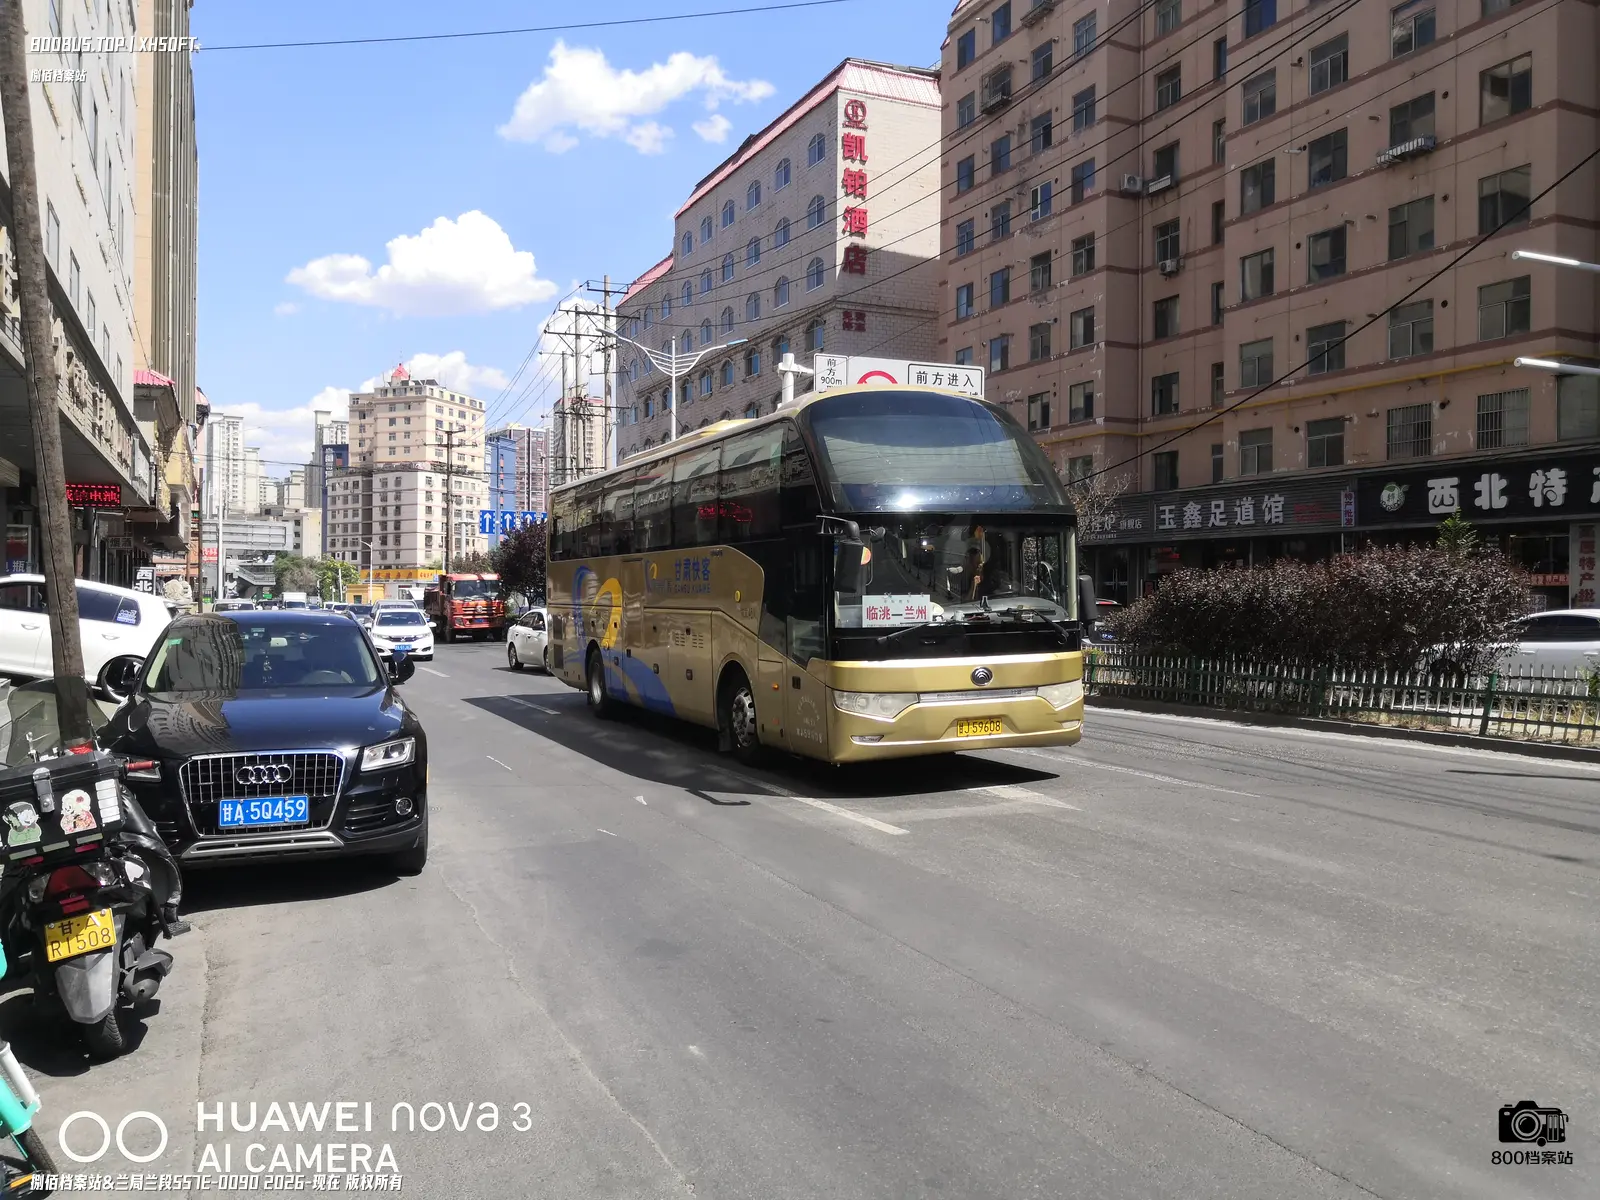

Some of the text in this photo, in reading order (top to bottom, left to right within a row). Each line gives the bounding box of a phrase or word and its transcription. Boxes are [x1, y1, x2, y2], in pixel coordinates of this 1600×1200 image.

[842, 132, 869, 276] 凯铂酒店
[820, 376, 843, 386] 900m
[915, 370, 974, 388] 前方进入
[1158, 493, 1285, 531] 玉鑫足道馆
[674, 556, 711, 582] 甘肃快客
[50, 927, 113, 960] R1508
